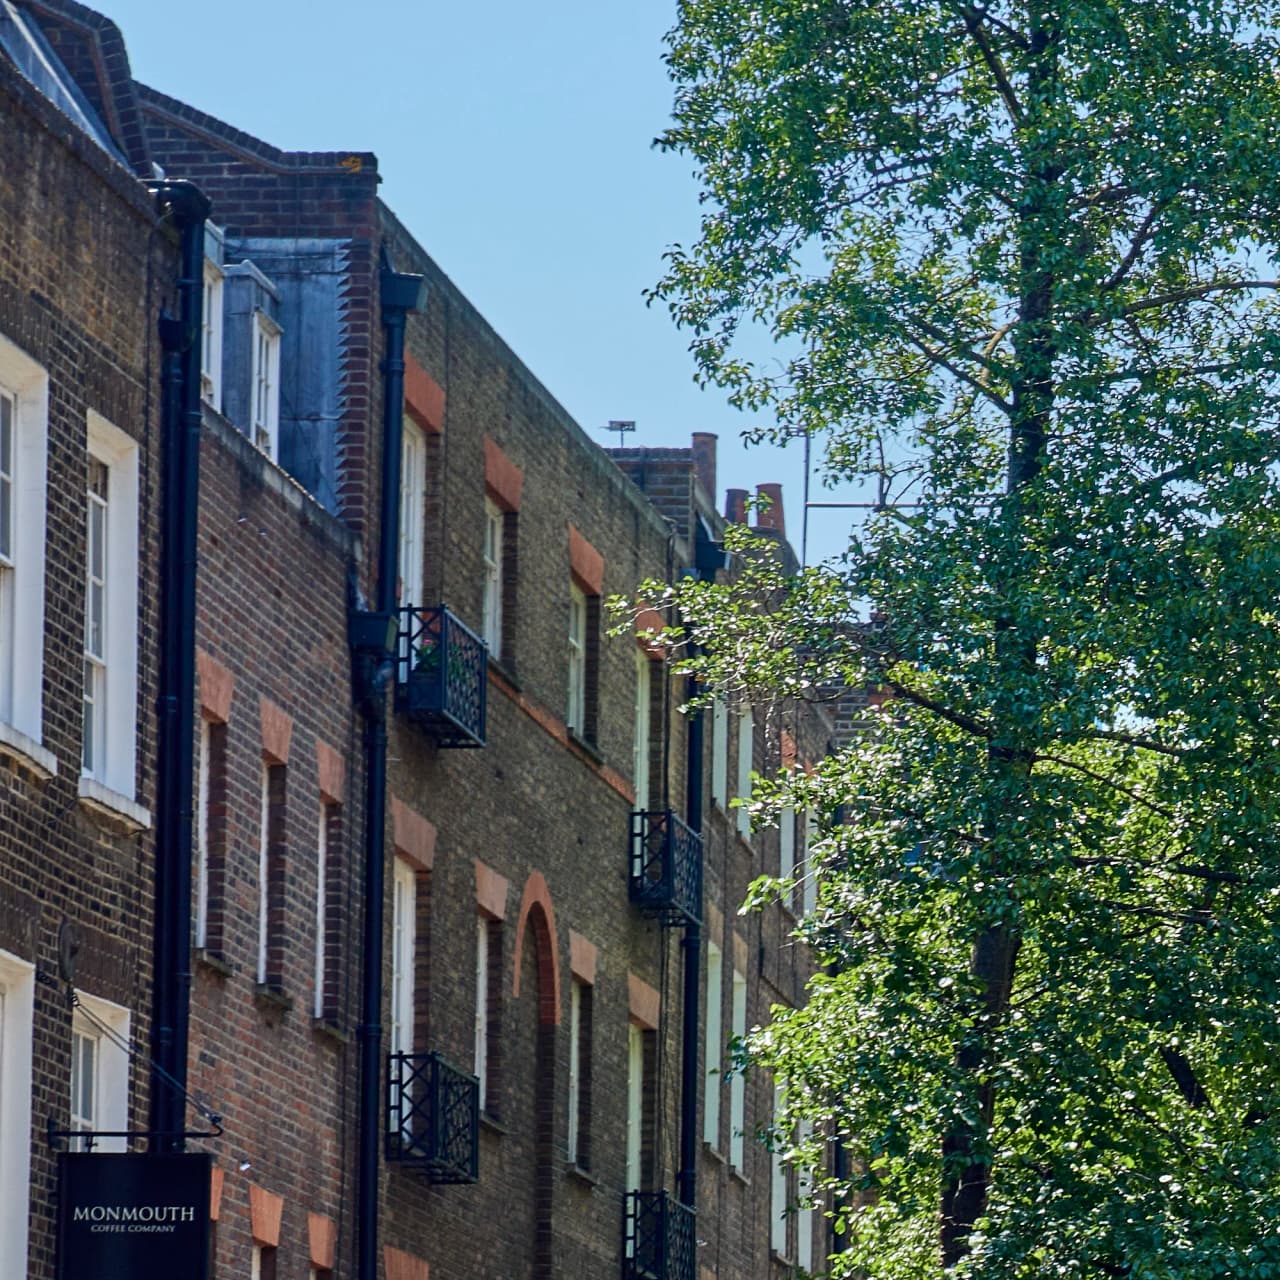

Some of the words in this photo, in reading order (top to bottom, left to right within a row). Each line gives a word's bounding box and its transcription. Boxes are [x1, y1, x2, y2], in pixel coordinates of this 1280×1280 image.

[73, 1206, 195, 1222] MONMOUTH
[91, 1225, 125, 1233] COFFEE
[128, 1225, 176, 1233] COMPANY
